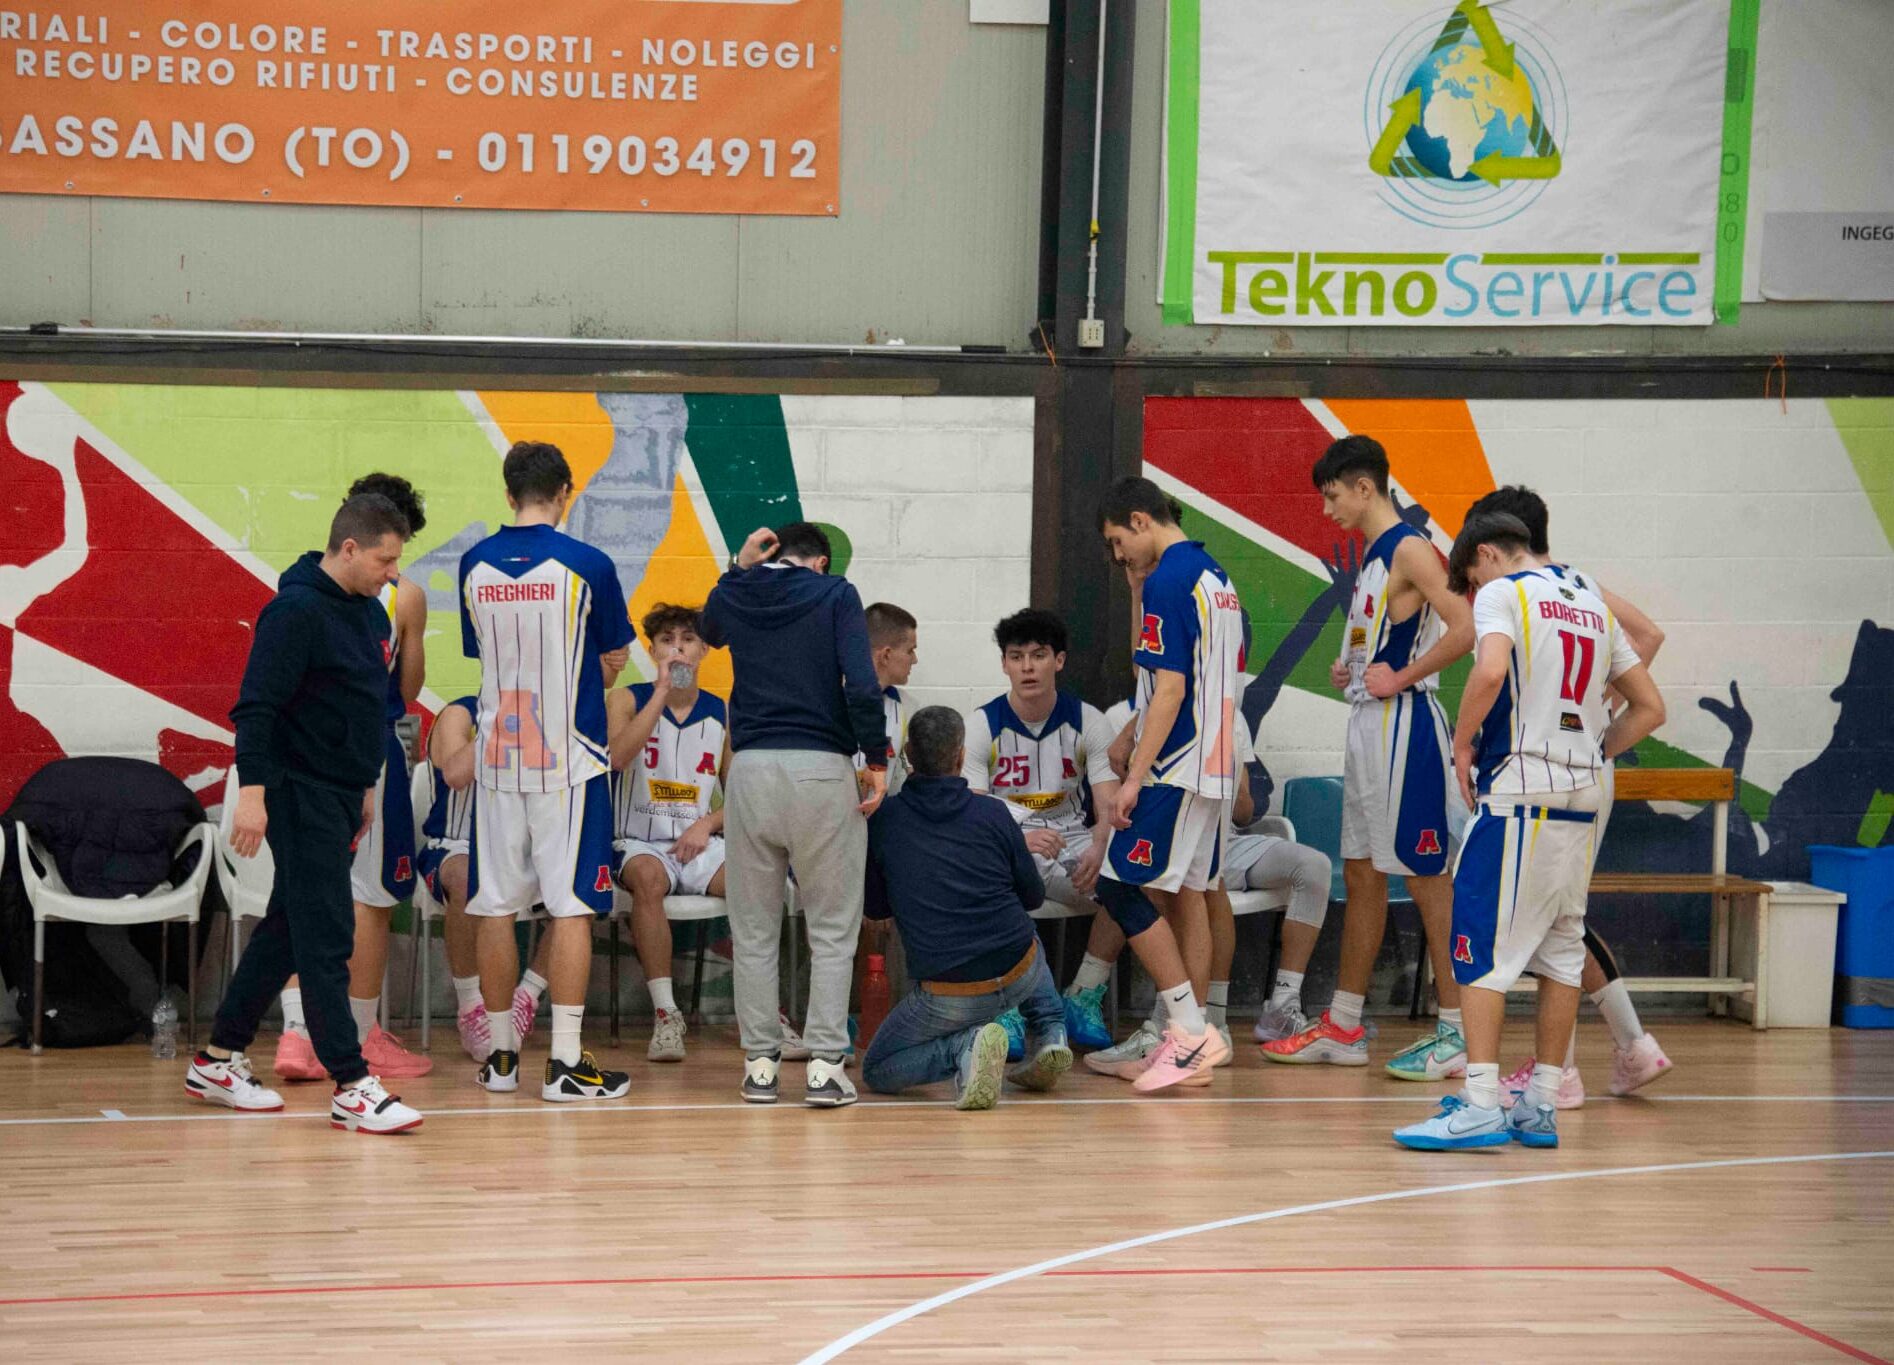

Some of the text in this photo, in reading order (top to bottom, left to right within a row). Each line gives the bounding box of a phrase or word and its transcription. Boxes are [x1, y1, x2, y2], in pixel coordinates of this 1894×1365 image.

[0, 11, 107, 44] RIALI
[161, 20, 327, 54] COLORE
[377, 30, 592, 64] TRASPORTI
[642, 39, 815, 69] NOLEGGI
[16, 48, 235, 86] RECUPERO
[257, 60, 396, 92] RIFIUTI
[446, 67, 697, 101] CONSULENZE
[0, 114, 255, 164] ASSANO
[284, 127, 410, 182] (TO)
[478, 132, 817, 178] 0119034912
[1842, 226, 1894, 241] INGEG
[1207, 251, 1700, 317] TeknoService
[477, 583, 556, 603] FREGHIERI
[1538, 601, 1605, 634] BORETTO
[1558, 629, 1595, 706] 11
[484, 689, 558, 770] A
[696, 752, 717, 776] A
[993, 756, 1030, 787] 25
[1127, 839, 1154, 867] A
[1415, 829, 1442, 855] A
[394, 856, 412, 882] A
[594, 865, 613, 893] A
